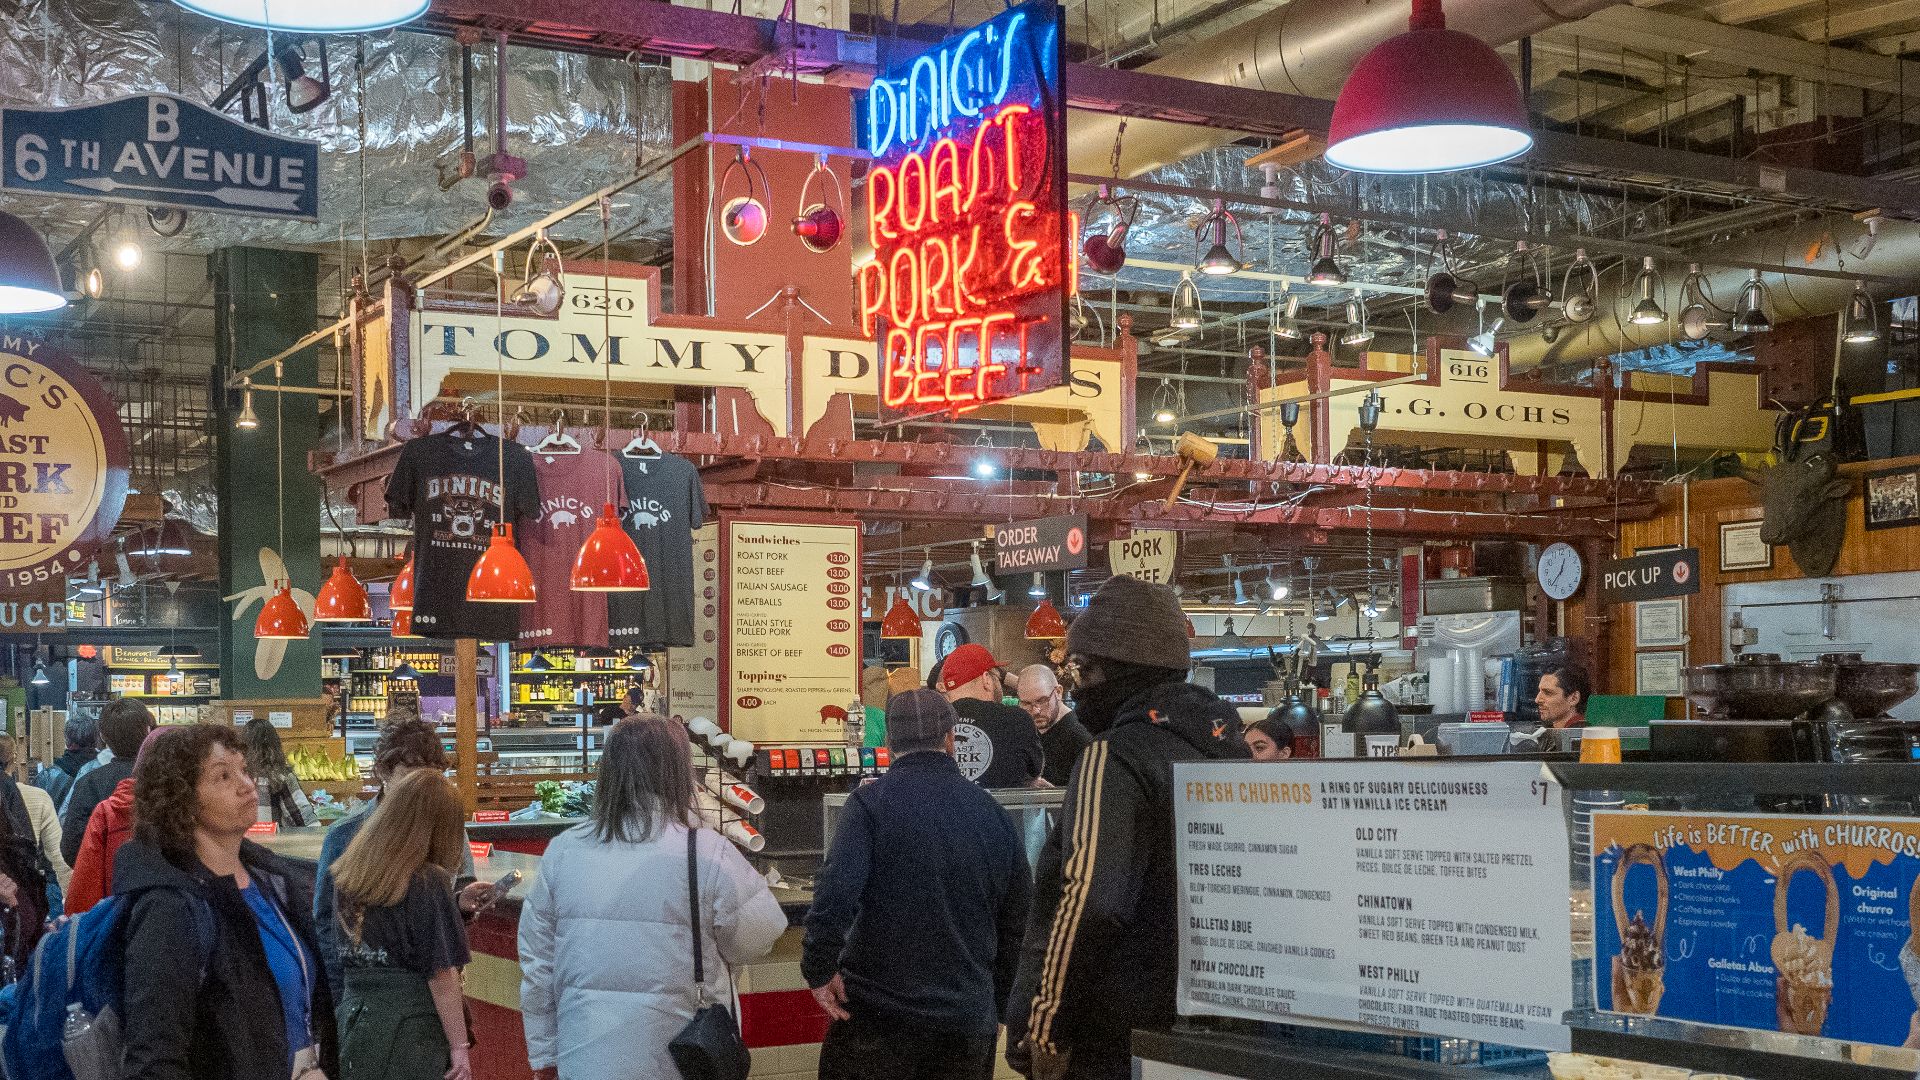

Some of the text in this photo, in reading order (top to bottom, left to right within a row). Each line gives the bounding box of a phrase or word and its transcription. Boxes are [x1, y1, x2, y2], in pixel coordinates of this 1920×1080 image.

[147, 96, 180, 143] B
[15, 133, 305, 192] 6 TH AVENUE
[867, 104, 1030, 249] ROAST
[860, 200, 1046, 338] PORK &
[571, 294, 634, 312] 620
[424, 324, 774, 374] TOMMY
[882, 311, 1016, 407] BEEF
[1450, 363, 1488, 378] 616
[1463, 402, 1570, 425] OCHS
[737, 533, 801, 547] Sandwiches
[998, 526, 1038, 548] ORDER
[737, 551, 849, 563] ROAST PORK 13.00
[998, 545, 1061, 569] TAKEAWAY
[1122, 537, 1162, 560] PORK
[1139, 557, 1146, 569] &
[6, 559, 65, 588] 1954
[737, 566, 849, 578] ROAST BEEF 13.00
[1604, 566, 1661, 590] PICK UP
[737, 581, 849, 593] ITALIAN SAUSAGE 13.00
[737, 598, 849, 608] MEATBALLS 13.00
[736, 618, 849, 630] ITALIAN STYLE 13.00
[736, 627, 791, 637] PULLED PORK
[736, 646, 849, 658] BRISKET OF BEEF 14.00
[737, 670, 788, 683] Toppings
[1371, 744, 1400, 757] TIPS
[1186, 782, 1312, 804] FRESH CHURROS
[1320, 782, 1488, 795] A RING OF SUGARY DELICIOUSNESS
[1322, 797, 1448, 812] SAT IN VANILLA ICE CREAM
[1188, 822, 1225, 835] ORIGINAL
[1355, 828, 1398, 842] OLD CITY
[1188, 840, 1298, 855] FRESH MADE CINNAMON SUGAR
[1653, 824, 1685, 850] Life
[1688, 824, 1701, 844] is
[1706, 823, 1774, 855] BETTER
[1781, 827, 1819, 854] with
[1356, 848, 1533, 866] VANILLA SOFT SERVE TOPPED WITH SALTED PRETZEL
[1189, 862, 1242, 877] TRES LECHES
[1382, 862, 1487, 879] DULCE DE TOFFEE BITES
[1674, 865, 1724, 880] West Philly
[1296, 889, 1331, 901] CONDENSED
[1852, 884, 1898, 901] Original
[1357, 894, 1412, 911] CHINATOWN
[1856, 901, 1894, 915] churro
[1190, 916, 1253, 933] GALLETAS ABUE
[1358, 914, 1540, 940] VANILLA SOFT SERVE TOPPED WITH CONDENSED MILK,
[1190, 936, 1335, 959] HOUSE DULCE CRUSHED VANILLA COOKIES
[1359, 928, 1526, 953] SWEET RED GREEN TEA AND PEANUT DUST
[1190, 959, 1265, 979] MAYAN CHOCOLATE
[1358, 964, 1419, 984] WEST PHILLY
[1707, 957, 1774, 974] Galletas Abue
[1227, 982, 1275, 997] DARK CHOCOLATE
[1266, 1001, 1291, 1012] POWDER
[1359, 985, 1551, 1018] VANILLA SOFT SERVE TOPPED WITH GUATEMALAN VEGAN
[1358, 1012, 1419, 1030] ESPRESSO POWDER
[1399, 1002, 1498, 1027] FAIR TRADE TOASTED COFFEE
